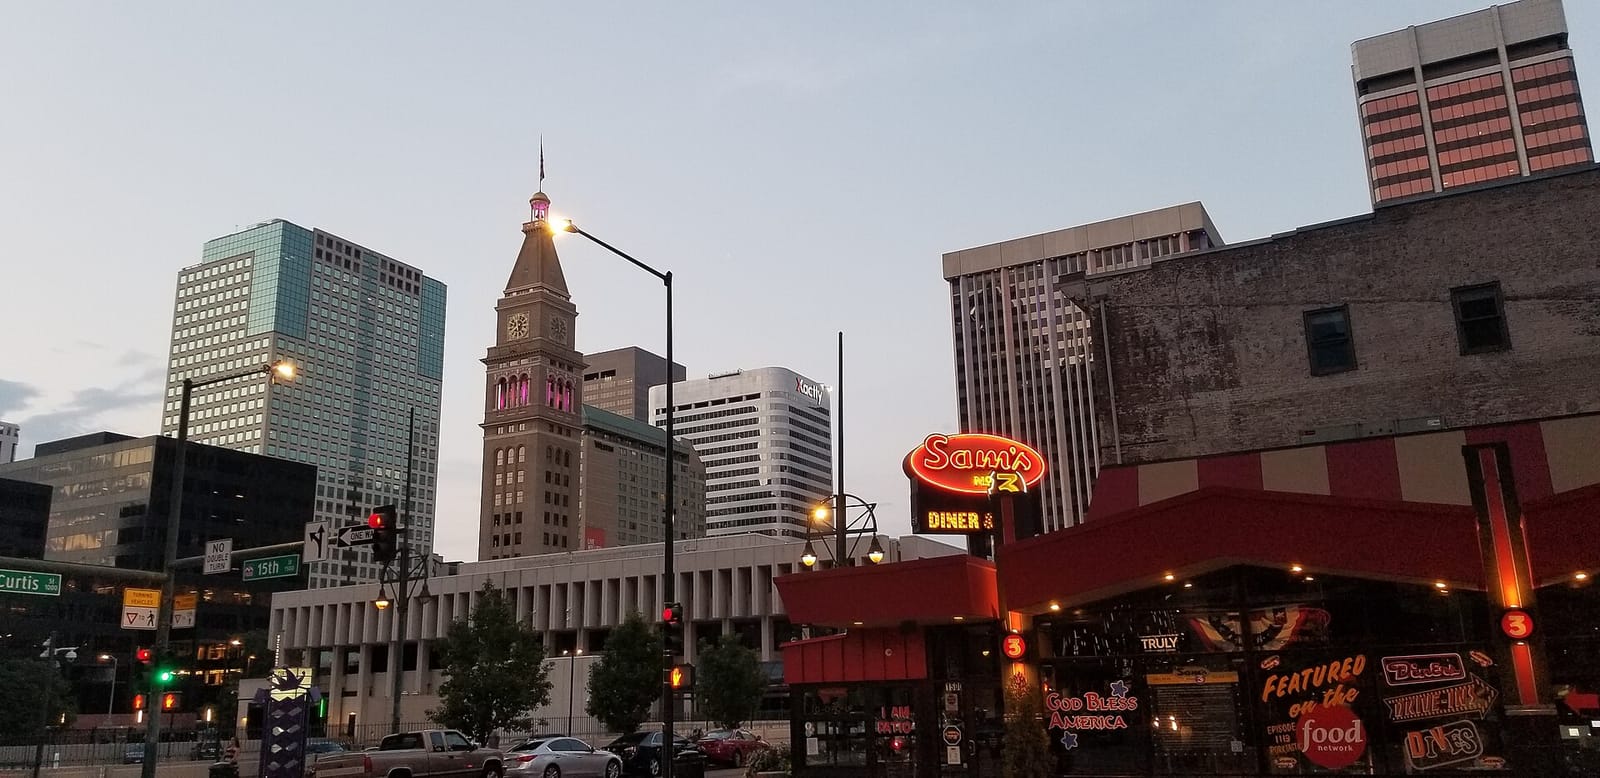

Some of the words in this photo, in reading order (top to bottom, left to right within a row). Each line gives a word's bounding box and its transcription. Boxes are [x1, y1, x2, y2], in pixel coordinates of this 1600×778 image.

[795, 376, 823, 405] Xactly
[924, 433, 1032, 471] Sam's
[928, 511, 980, 530] DINER
[350, 530, 364, 540] ONE
[364, 529, 375, 539] WA
[212, 543, 225, 553] NO
[207, 552, 229, 563] DOUBLE
[209, 562, 226, 571] TURN
[257, 560, 280, 576] 15th
[0, 574, 40, 591] Curtis
[1507, 615, 1527, 636] 3
[1007, 638, 1022, 656] 3
[1140, 636, 1178, 650] TRULY
[1262, 654, 1366, 703] FEATURED
[1046, 692, 1083, 712] GOD
[1083, 691, 1138, 712] BLESS
[1288, 700, 1318, 719] on
[1322, 684, 1361, 709] the
[881, 706, 887, 719] I
[891, 705, 911, 720] AM
[1048, 711, 1128, 731] AMERICA
[877, 720, 913, 735] PATIO
[1266, 722, 1297, 735] EPISODE
[1302, 719, 1364, 753] food
[1407, 726, 1478, 759] DIVES
